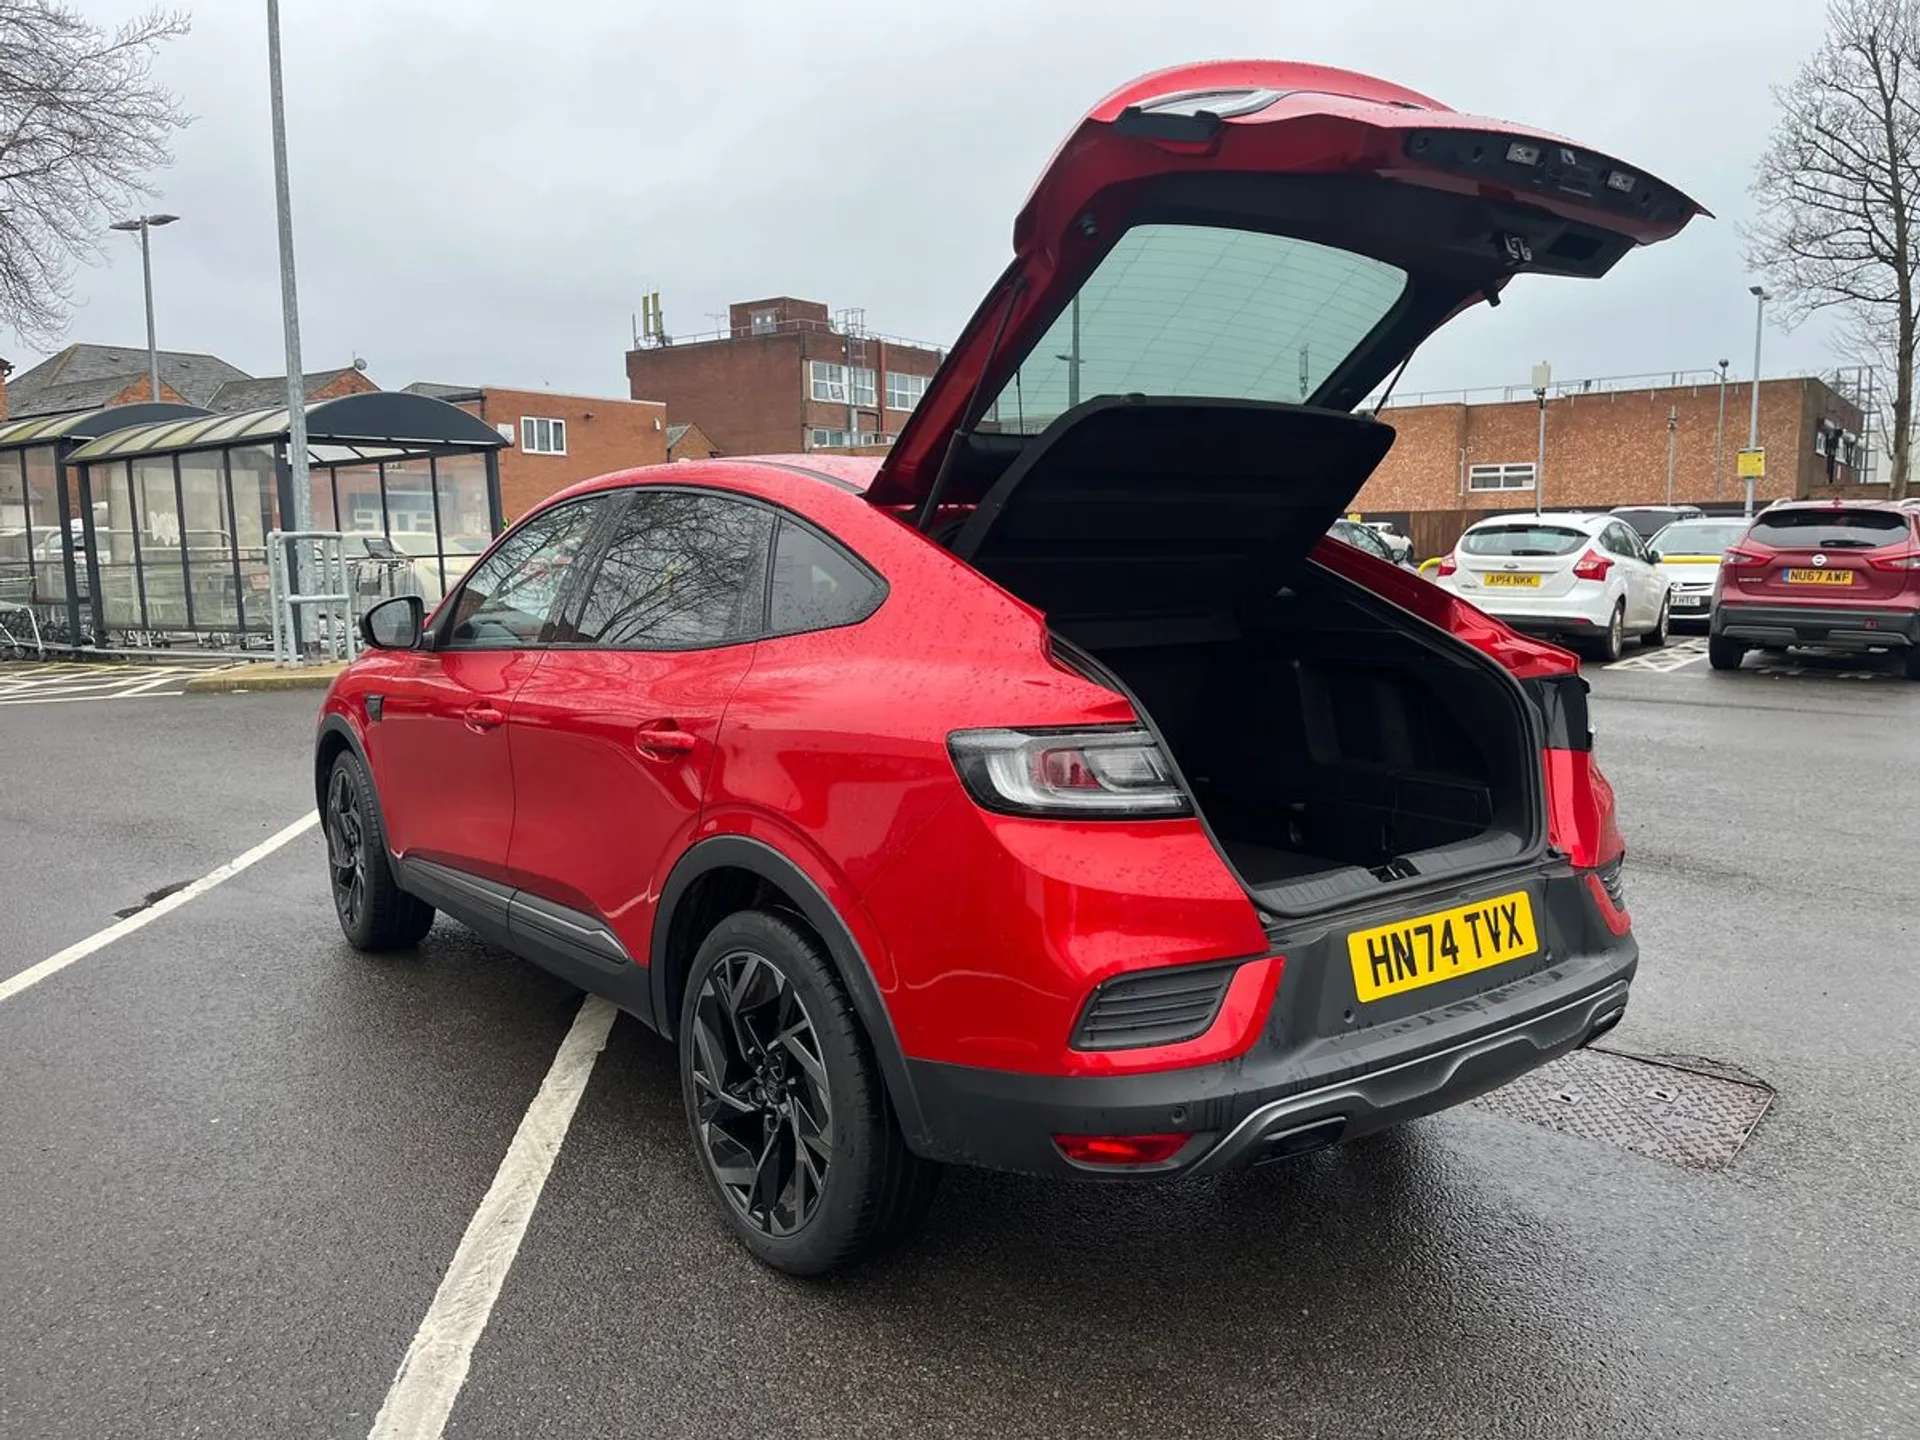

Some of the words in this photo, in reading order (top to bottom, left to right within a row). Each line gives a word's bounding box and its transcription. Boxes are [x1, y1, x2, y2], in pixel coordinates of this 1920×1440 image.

[1790, 570, 1823, 582] NU67
[1366, 919, 1459, 987] HN74
[1464, 901, 1524, 959] TVX
